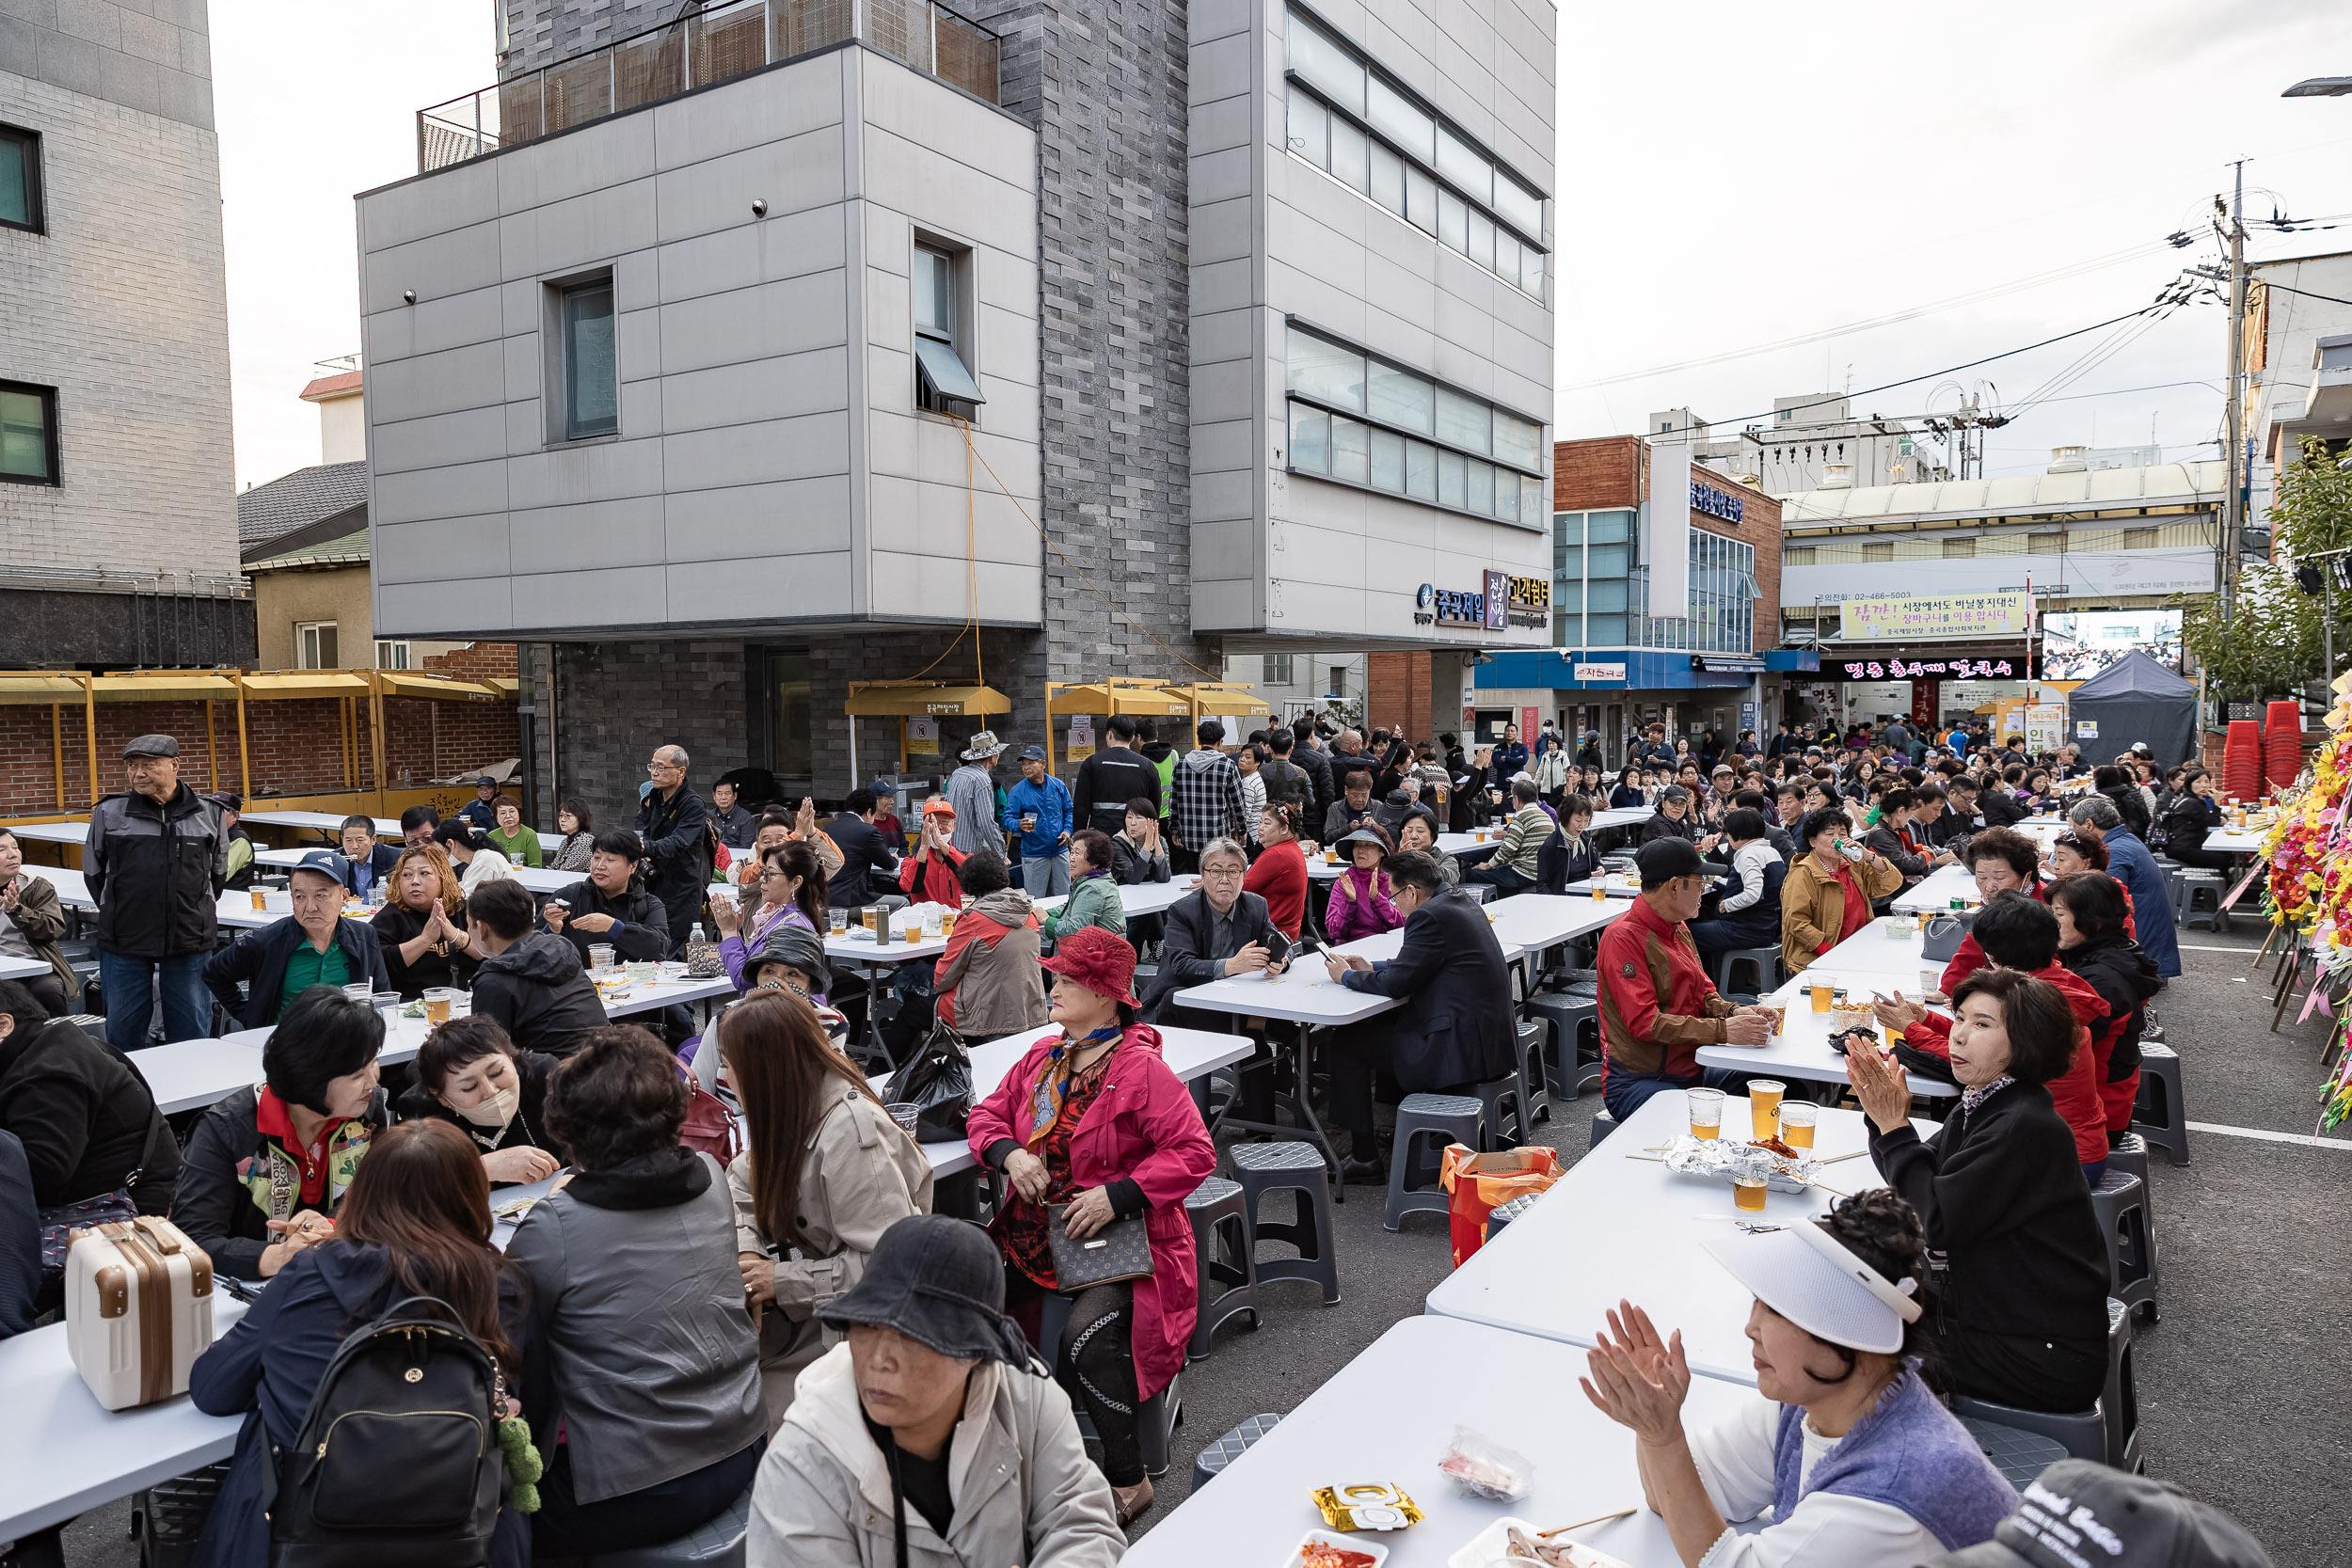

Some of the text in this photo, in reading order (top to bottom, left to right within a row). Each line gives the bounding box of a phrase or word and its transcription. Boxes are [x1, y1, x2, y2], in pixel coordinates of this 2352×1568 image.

[1510, 577, 1549, 607] 고객쉼터
[1854, 591, 1912, 601] 02-466-5003
[1438, 590, 1484, 623] 중곡제일
[1490, 603, 1504, 626] 시장
[1852, 596, 2017, 622] 잠깐! 시장에서도 비닐봉지대신
[1902, 609, 2010, 625] 장바구니를 이용 합시다.
[1929, 625, 1986, 634] 중곡종합사회복지관
[1845, 658, 2012, 679] 명동 홍두깨 칼국수
[927, 704, 960, 714] 중곡제일시장
